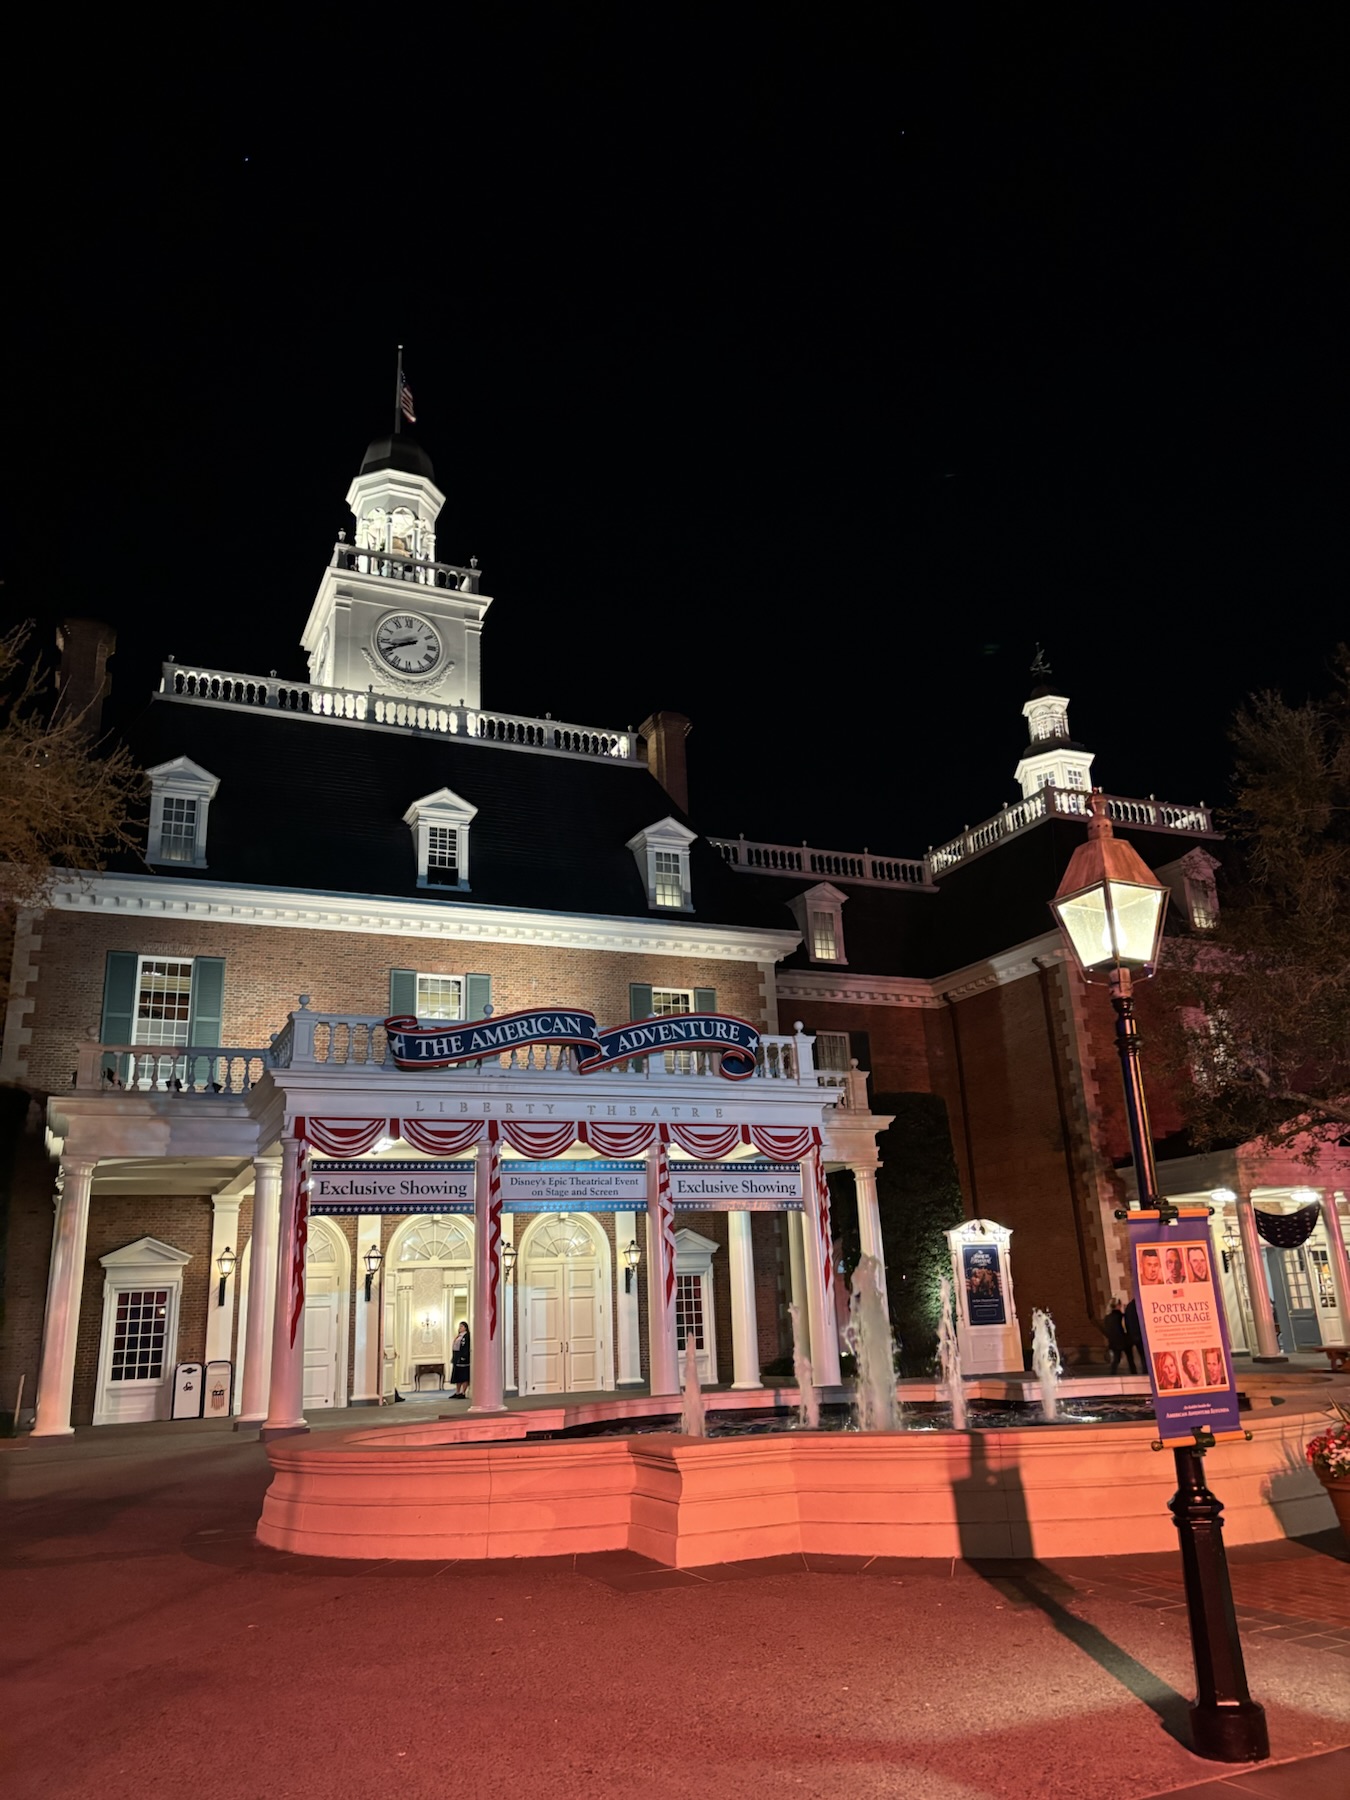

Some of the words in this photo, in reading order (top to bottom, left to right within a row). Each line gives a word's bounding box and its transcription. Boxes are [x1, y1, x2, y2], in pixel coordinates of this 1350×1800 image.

[415, 1035, 465, 1057] THE
[469, 1016, 582, 1051] AMERICAN
[617, 1021, 740, 1052] ADVENTURE
[416, 1101, 555, 1115] LIBERTY
[586, 1104, 724, 1118] THEATRE
[319, 1180, 396, 1196] Exclusive
[400, 1180, 468, 1197] Showing
[510, 1177, 546, 1187] Disney's
[548, 1177, 567, 1187] Epic
[568, 1177, 612, 1185] Theatrical
[614, 1177, 639, 1185] Event
[677, 1180, 739, 1194] Exclusive
[741, 1180, 797, 1196] Showing
[545, 1187, 569, 1197] Stage
[571, 1187, 588, 1196] and
[590, 1187, 619, 1196] Screen
[1151, 1301, 1210, 1314] PORTRAITS
[1163, 1312, 1211, 1324] COURAGE
